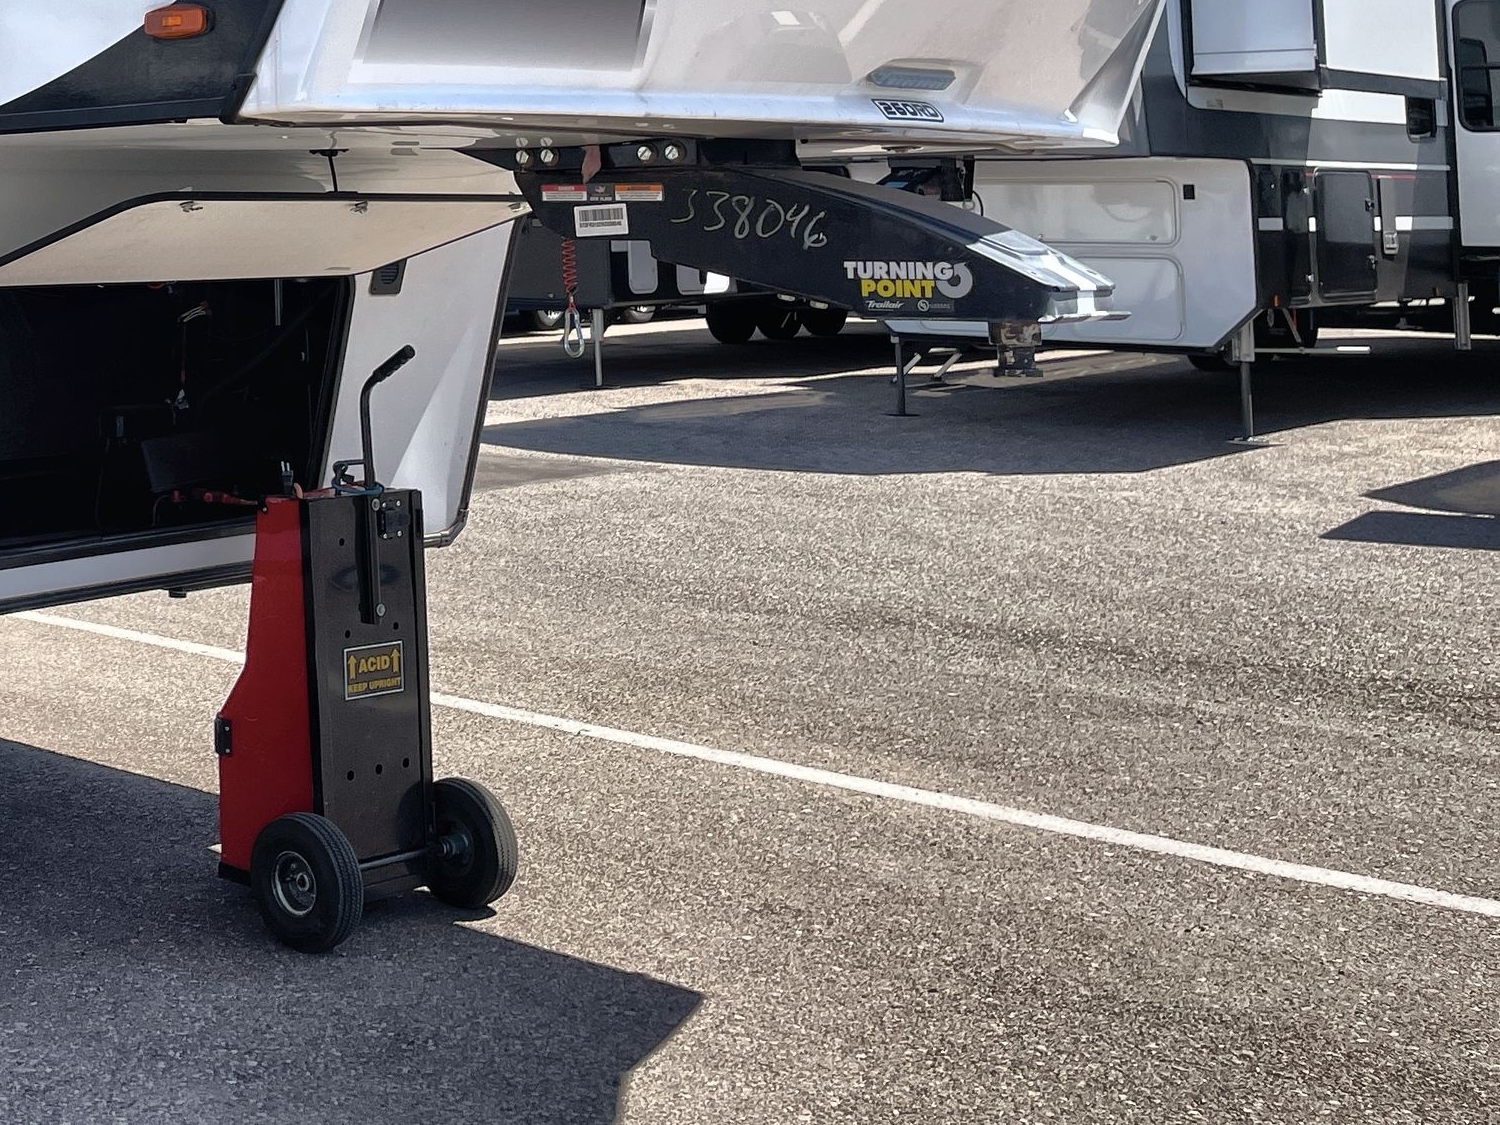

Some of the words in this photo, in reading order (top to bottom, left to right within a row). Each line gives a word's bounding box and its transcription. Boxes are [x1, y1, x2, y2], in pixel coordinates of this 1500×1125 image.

[670, 188, 828, 250] 338046
[843, 261, 954, 281] TURNING
[861, 279, 935, 298] POINT
[358, 655, 391, 674] ACID
